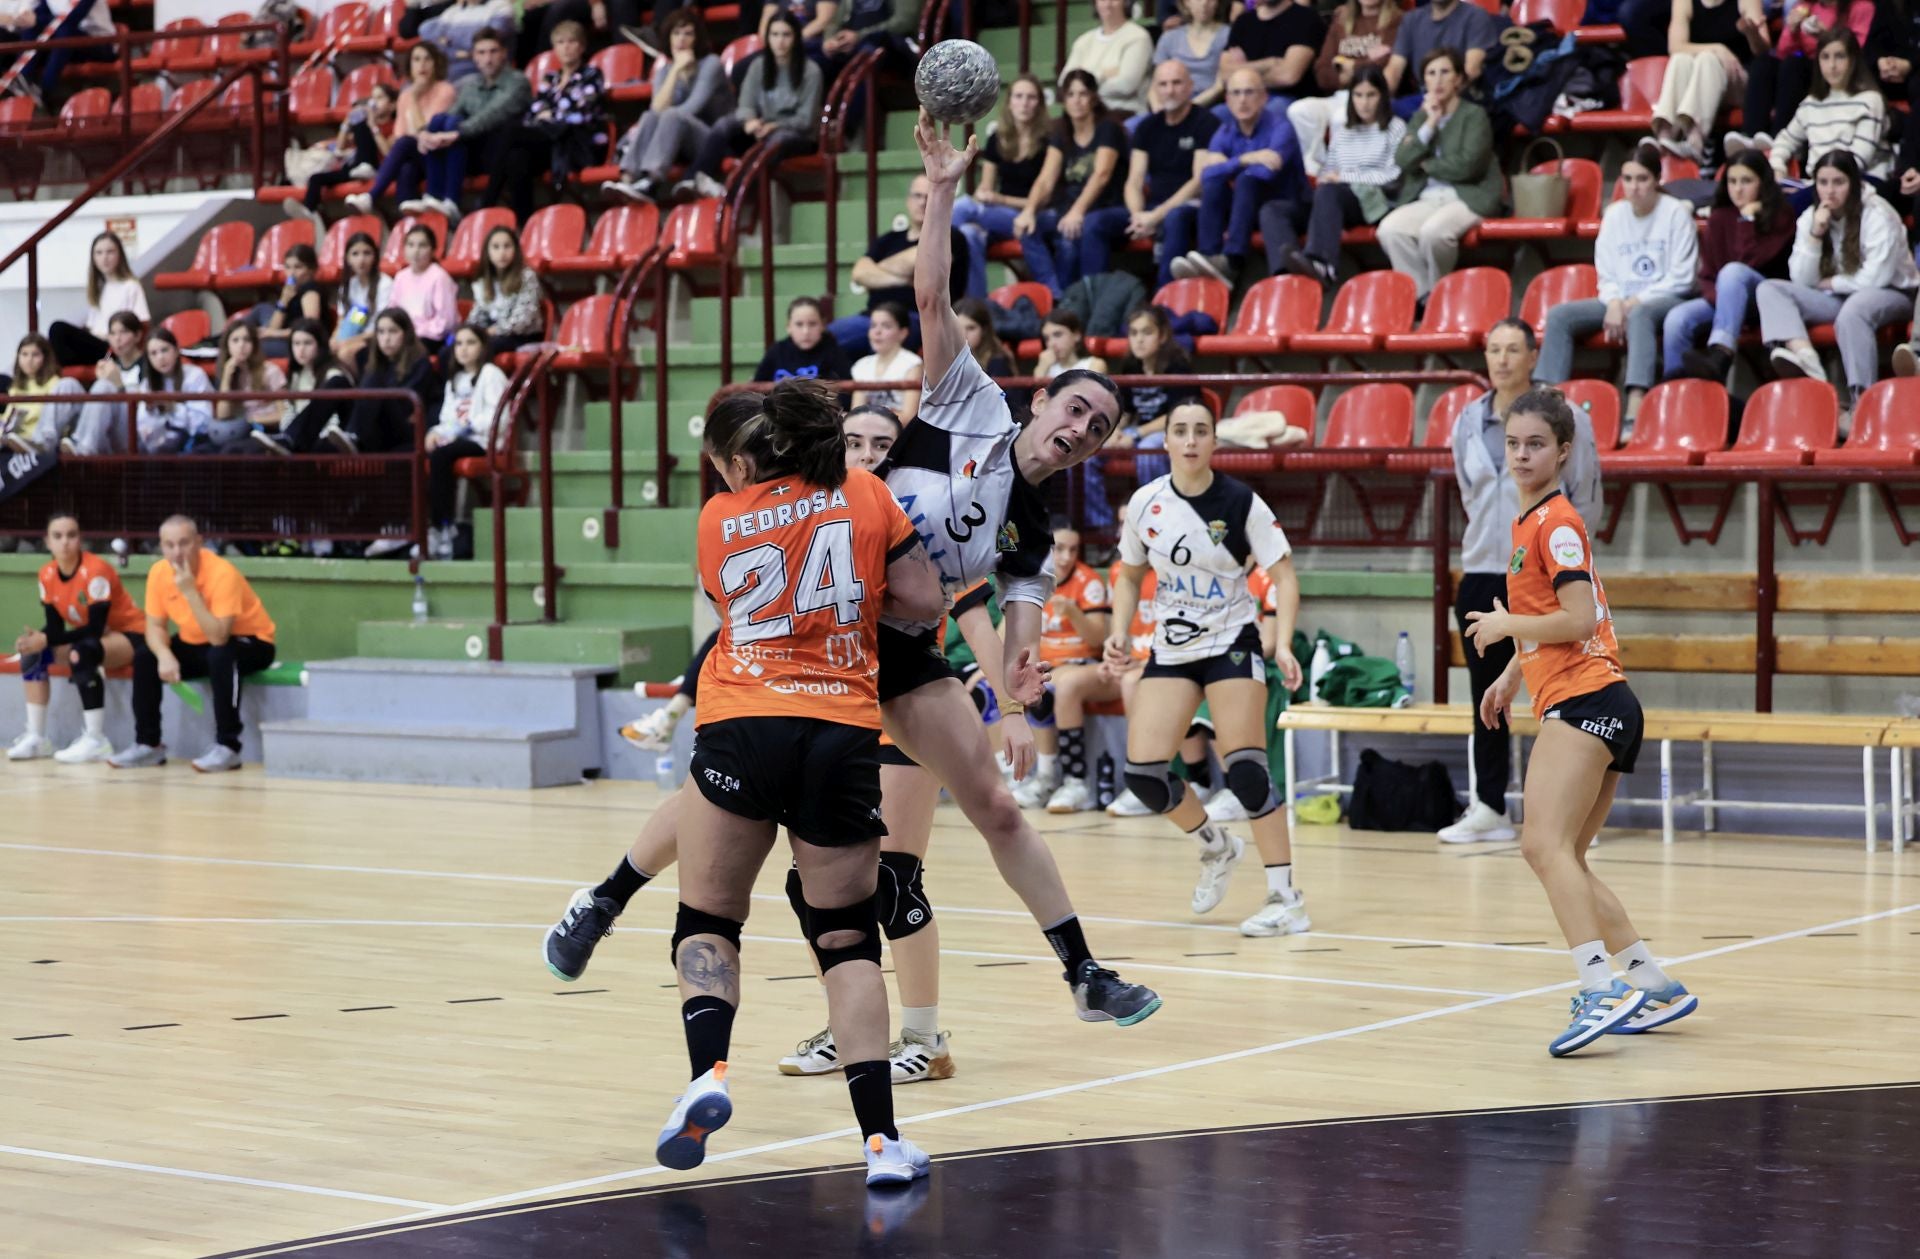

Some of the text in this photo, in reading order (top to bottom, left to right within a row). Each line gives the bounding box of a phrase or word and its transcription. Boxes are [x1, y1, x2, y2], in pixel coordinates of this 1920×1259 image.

[721, 487, 848, 543] PEDROSA
[945, 501, 986, 543] 3
[1170, 534, 1192, 566] 6
[718, 519, 863, 646] 24
[1581, 719, 1615, 740] EZETZ!
